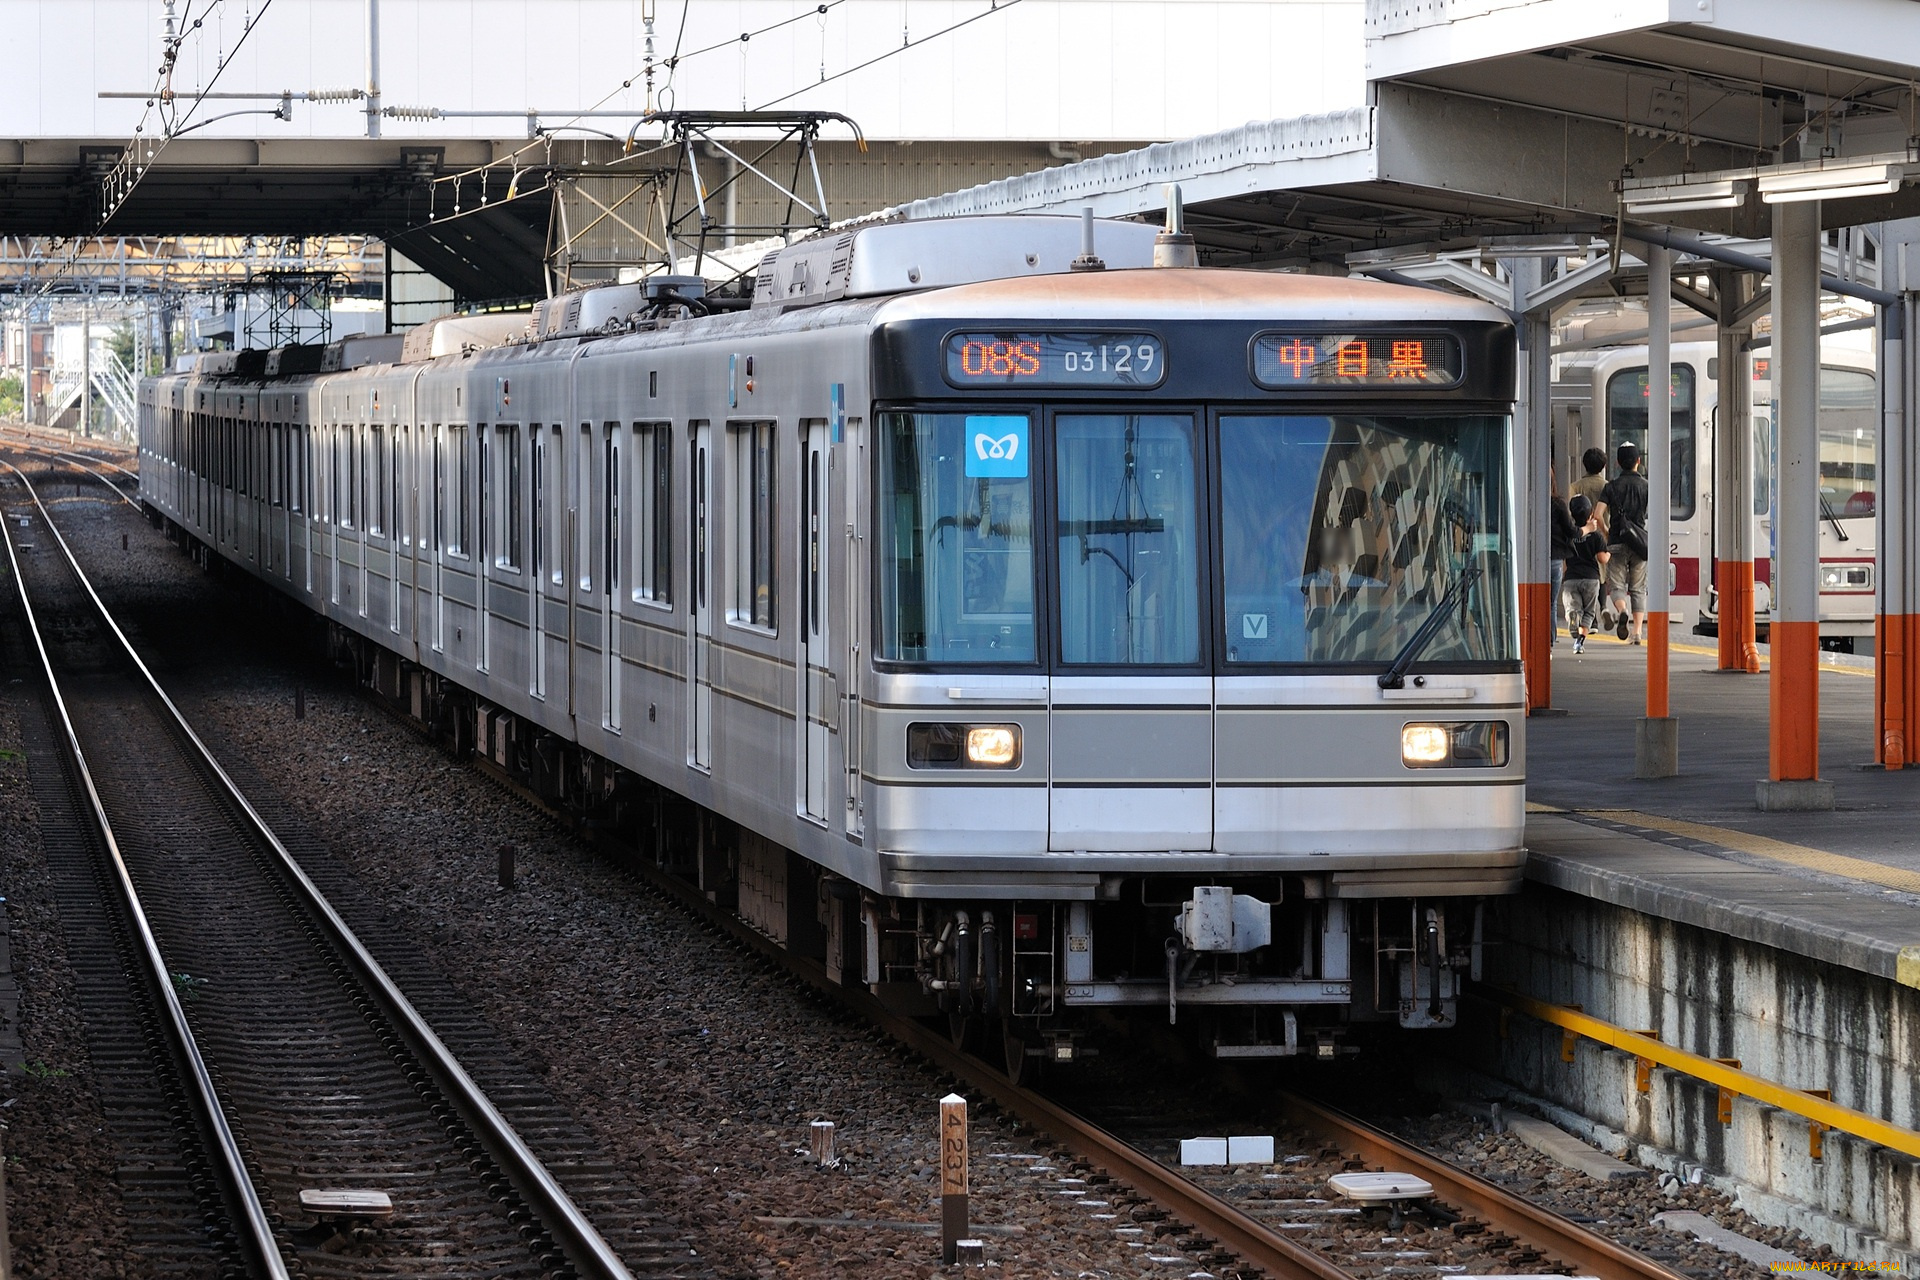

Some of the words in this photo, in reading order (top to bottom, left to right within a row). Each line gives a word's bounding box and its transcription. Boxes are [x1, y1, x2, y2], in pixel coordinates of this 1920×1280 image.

[961, 340, 1041, 377] 08S
[1064, 343, 1156, 373] 03129
[1279, 338, 1429, 379] 中目黒
[1246, 616, 1265, 635] V
